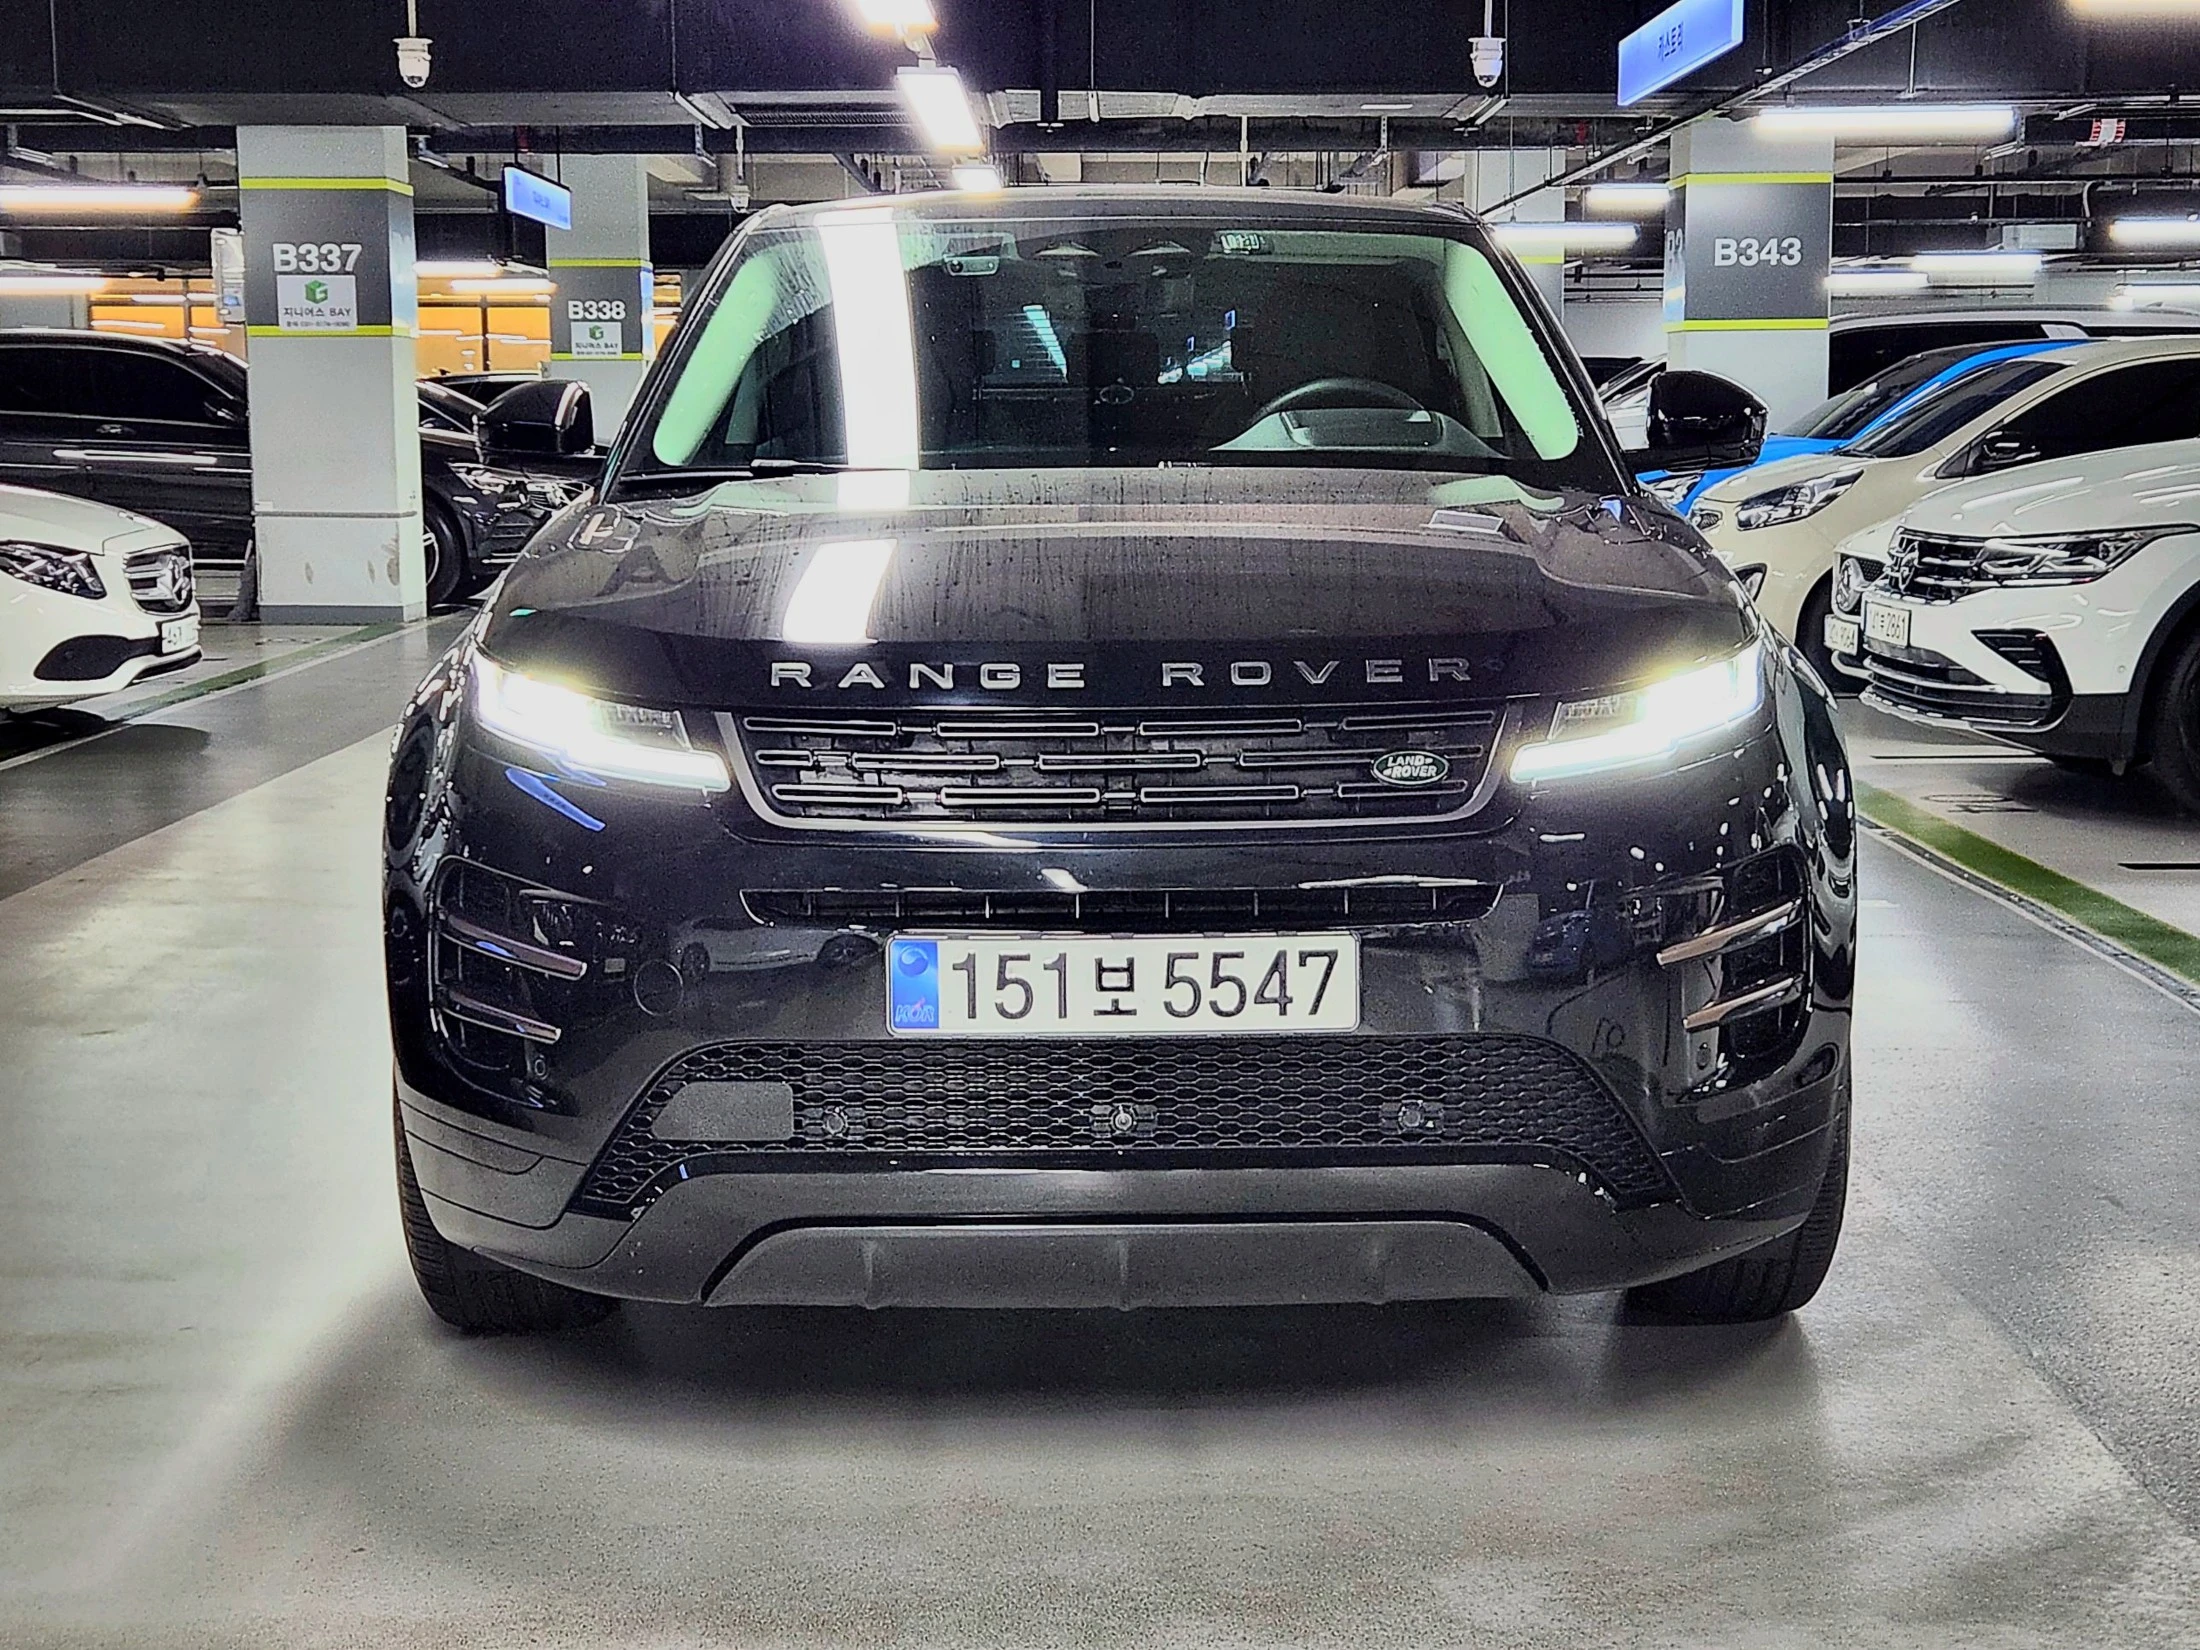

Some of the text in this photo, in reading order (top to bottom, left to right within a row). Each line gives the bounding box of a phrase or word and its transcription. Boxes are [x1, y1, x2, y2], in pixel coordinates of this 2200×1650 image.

[272, 243, 363, 273] B337
[1714, 237, 1802, 267] B343
[283, 306, 352, 317] 지니어스 BAY
[568, 300, 627, 320] B338
[770, 658, 1471, 689] RANGE ROVER
[1387, 755, 1425, 767] LAND
[1391, 765, 1438, 778] ROVER
[1162, 949, 1339, 1018] 5547
[895, 1003, 935, 1023] KOR
